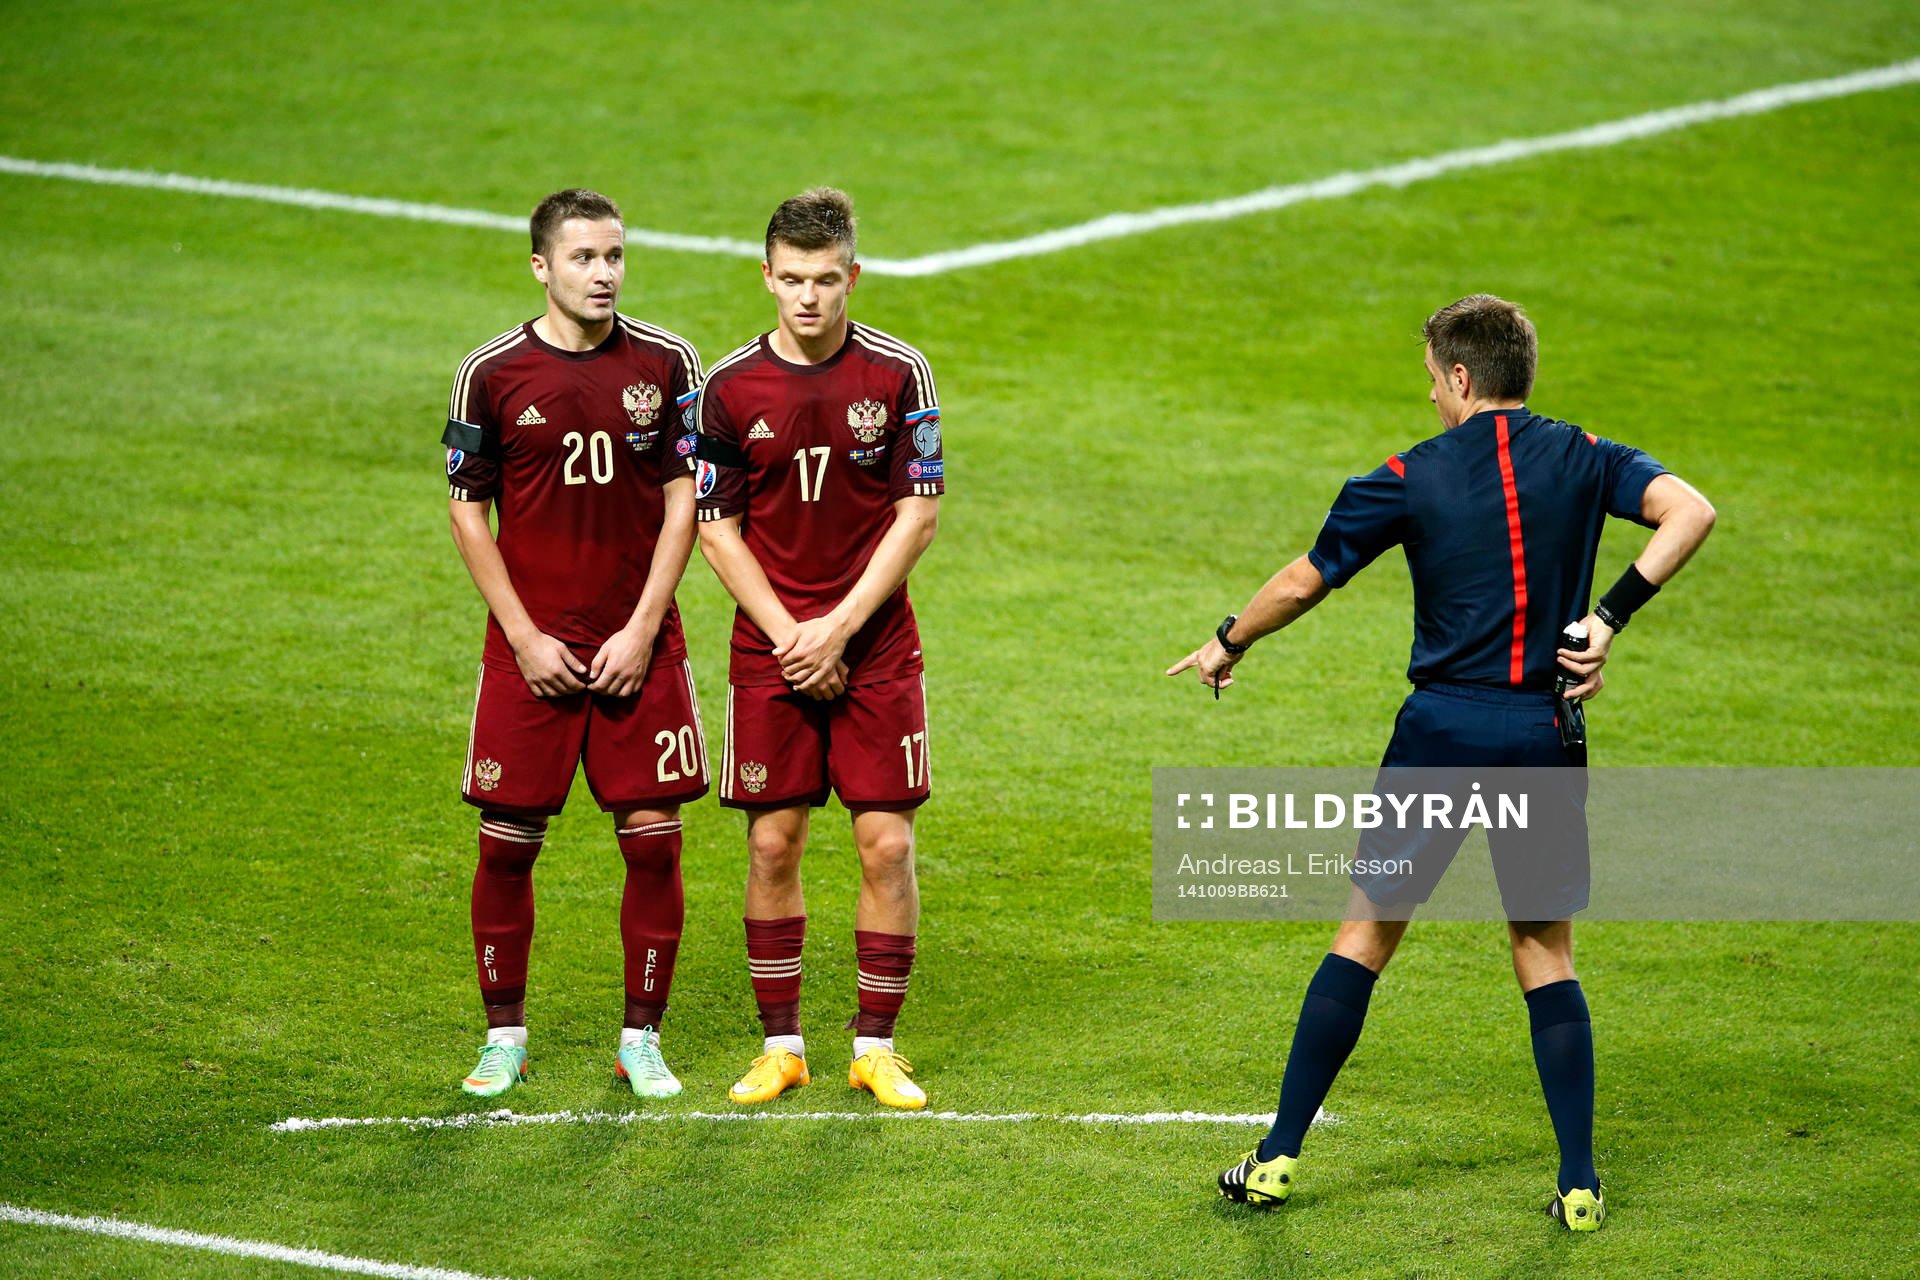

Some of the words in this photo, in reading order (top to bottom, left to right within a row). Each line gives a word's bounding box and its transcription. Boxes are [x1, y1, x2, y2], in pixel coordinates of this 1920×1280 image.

[516, 416, 547, 426] adidas
[748, 430, 775, 439] adidas
[562, 430, 614, 486] 20
[793, 446, 831, 502] 17
[654, 725, 699, 783] 20
[900, 730, 925, 789] 17
[483, 944, 499, 983] RFU
[643, 948, 657, 991] RFU
